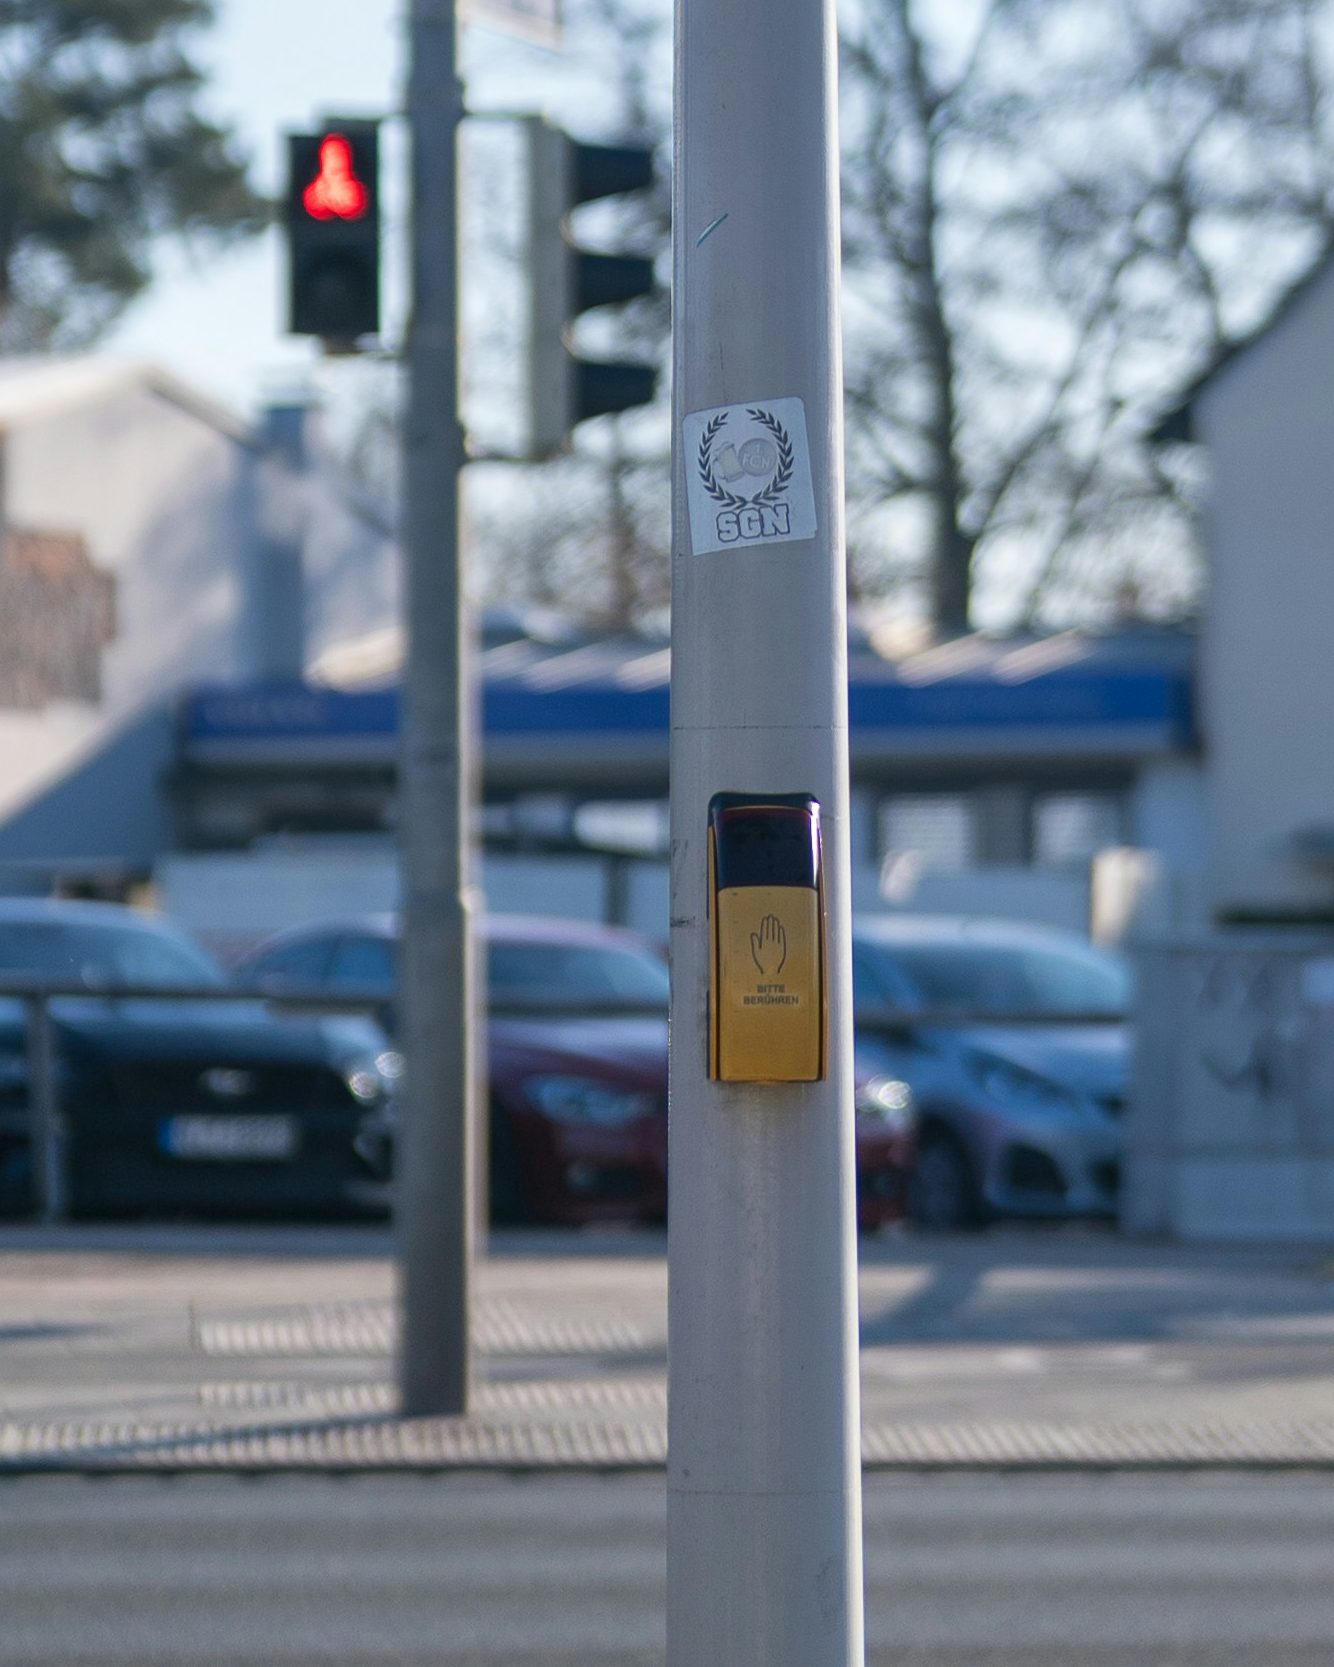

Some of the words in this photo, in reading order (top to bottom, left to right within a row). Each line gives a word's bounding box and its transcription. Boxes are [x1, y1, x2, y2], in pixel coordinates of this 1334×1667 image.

[716, 503, 791, 543] SGN
[757, 984, 786, 994] BITTE
[743, 994, 799, 1005] BERÜHREN
